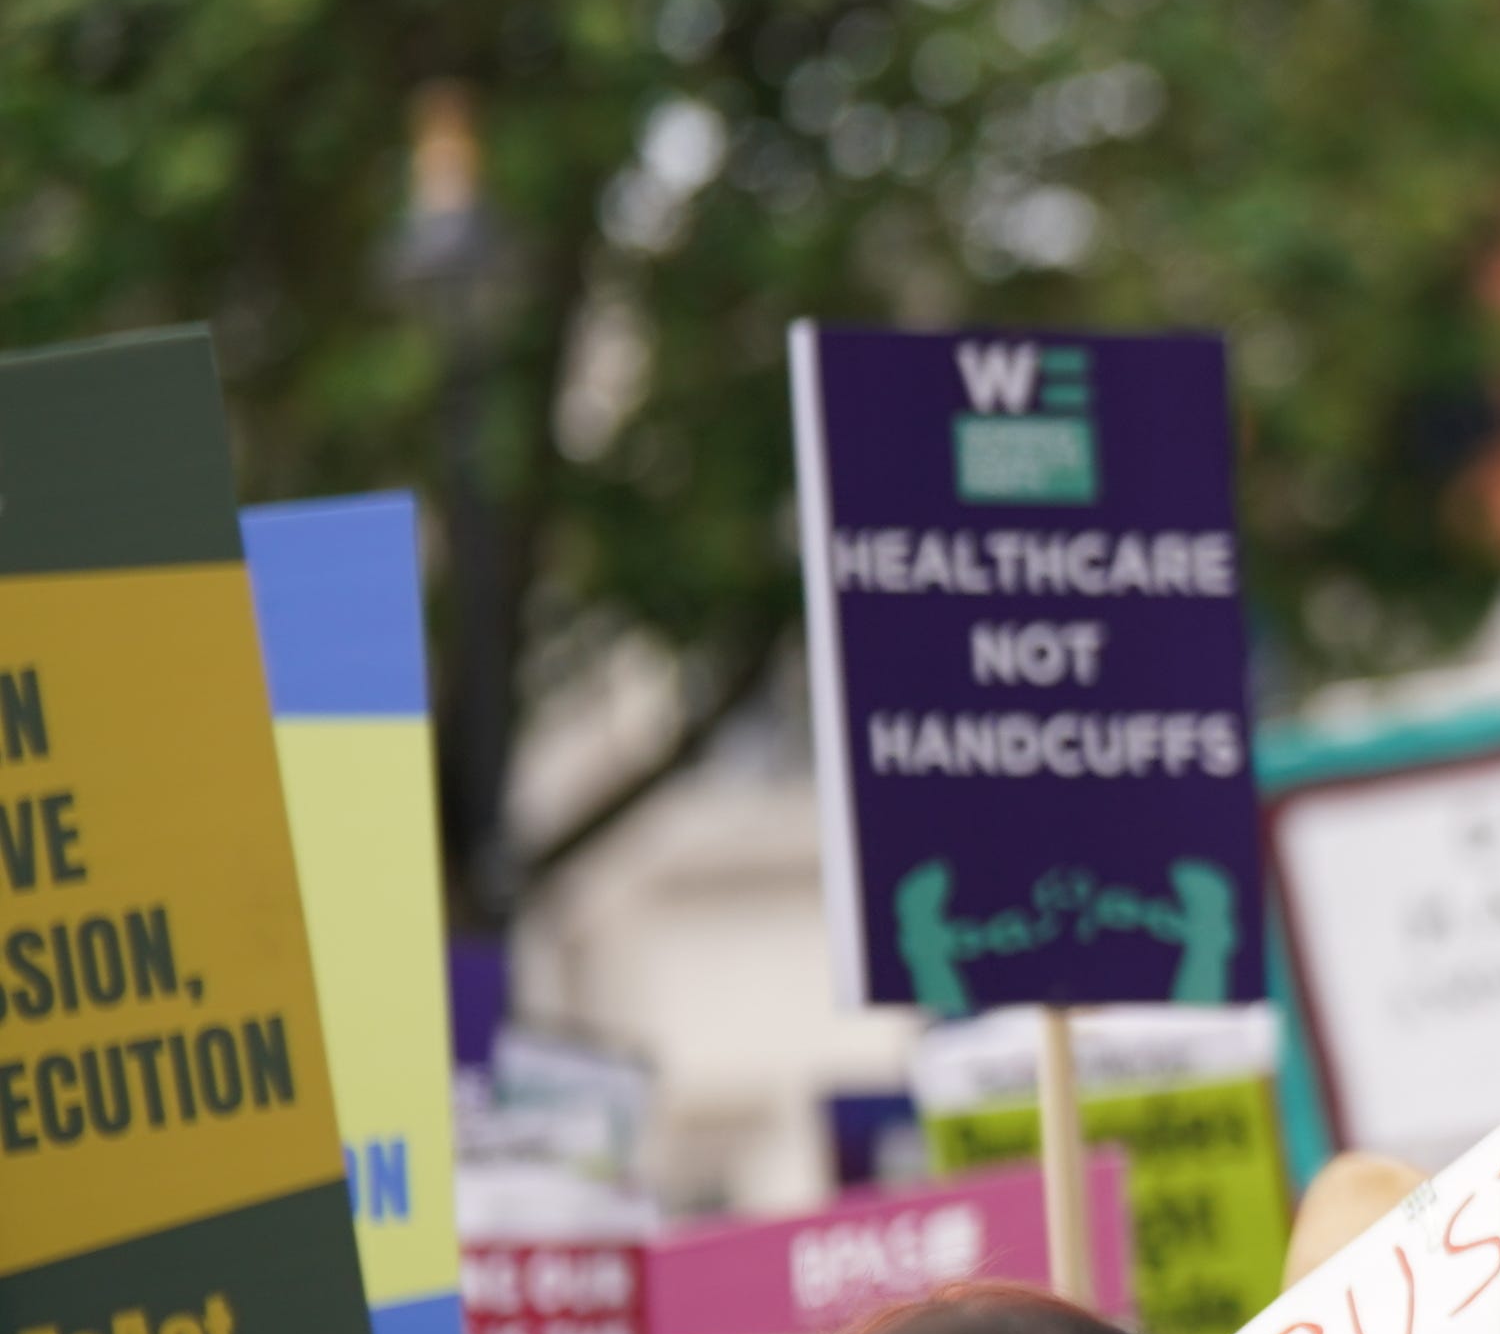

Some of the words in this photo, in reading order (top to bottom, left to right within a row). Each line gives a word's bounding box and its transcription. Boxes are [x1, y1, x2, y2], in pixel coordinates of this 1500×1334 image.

[834, 529, 1235, 597] HEALTHCARE
[969, 620, 1104, 686] NOT
[869, 711, 1241, 778] HANDCUFFS
[0, 902, 206, 1027] SION,
[0, 1014, 297, 1154] ECUTION
